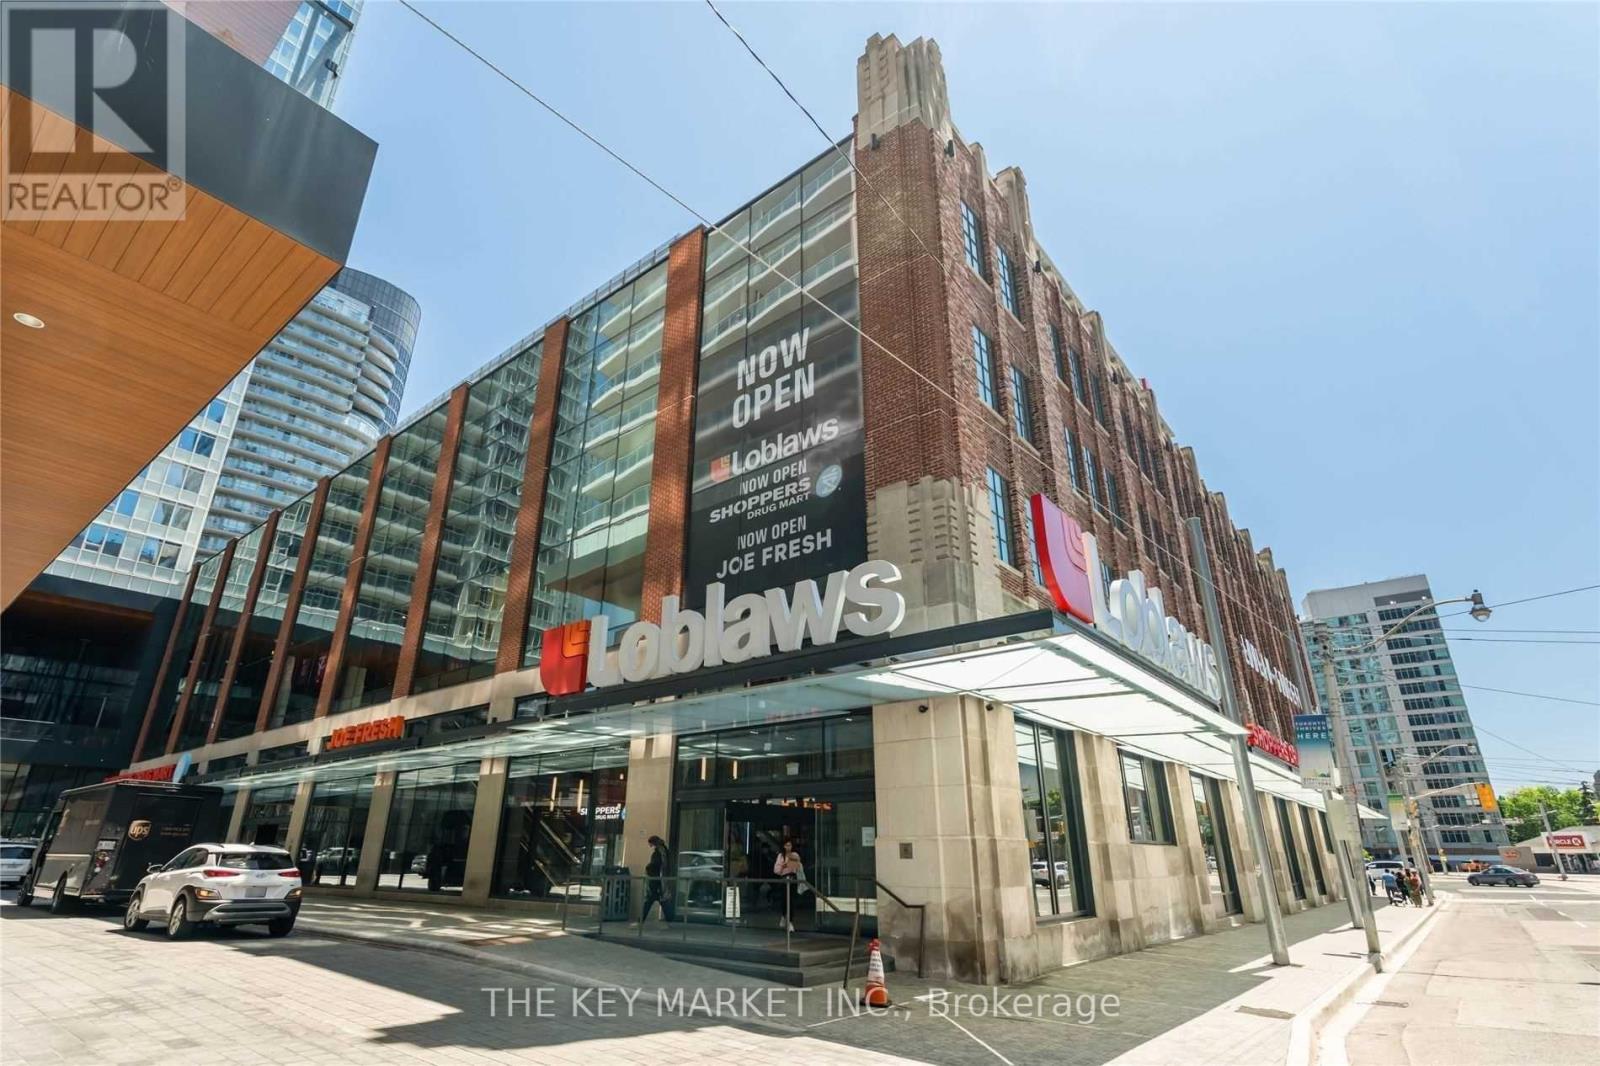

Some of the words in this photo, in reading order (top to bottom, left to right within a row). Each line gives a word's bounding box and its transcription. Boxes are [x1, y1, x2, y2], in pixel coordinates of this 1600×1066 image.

[737, 327, 810, 390] NOW
[731, 361, 816, 429] OPEN
[731, 417, 840, 476] Loblaws
[709, 476, 811, 523] SHOPPERS
[739, 471, 769, 496] NOW
[772, 458, 807, 484] OPEN
[747, 504, 777, 520] DRUG
[779, 491, 811, 510] MART
[716, 552, 755, 579] JOE
[761, 528, 832, 566] FRESH
[737, 527, 768, 551] NOW
[771, 515, 807, 540] OPEN
[588, 558, 906, 687] Loblaws
[1081, 531, 1222, 700] Loblaws
[355, 715, 405, 744] FRESH
[130, 824, 151, 838] ups
